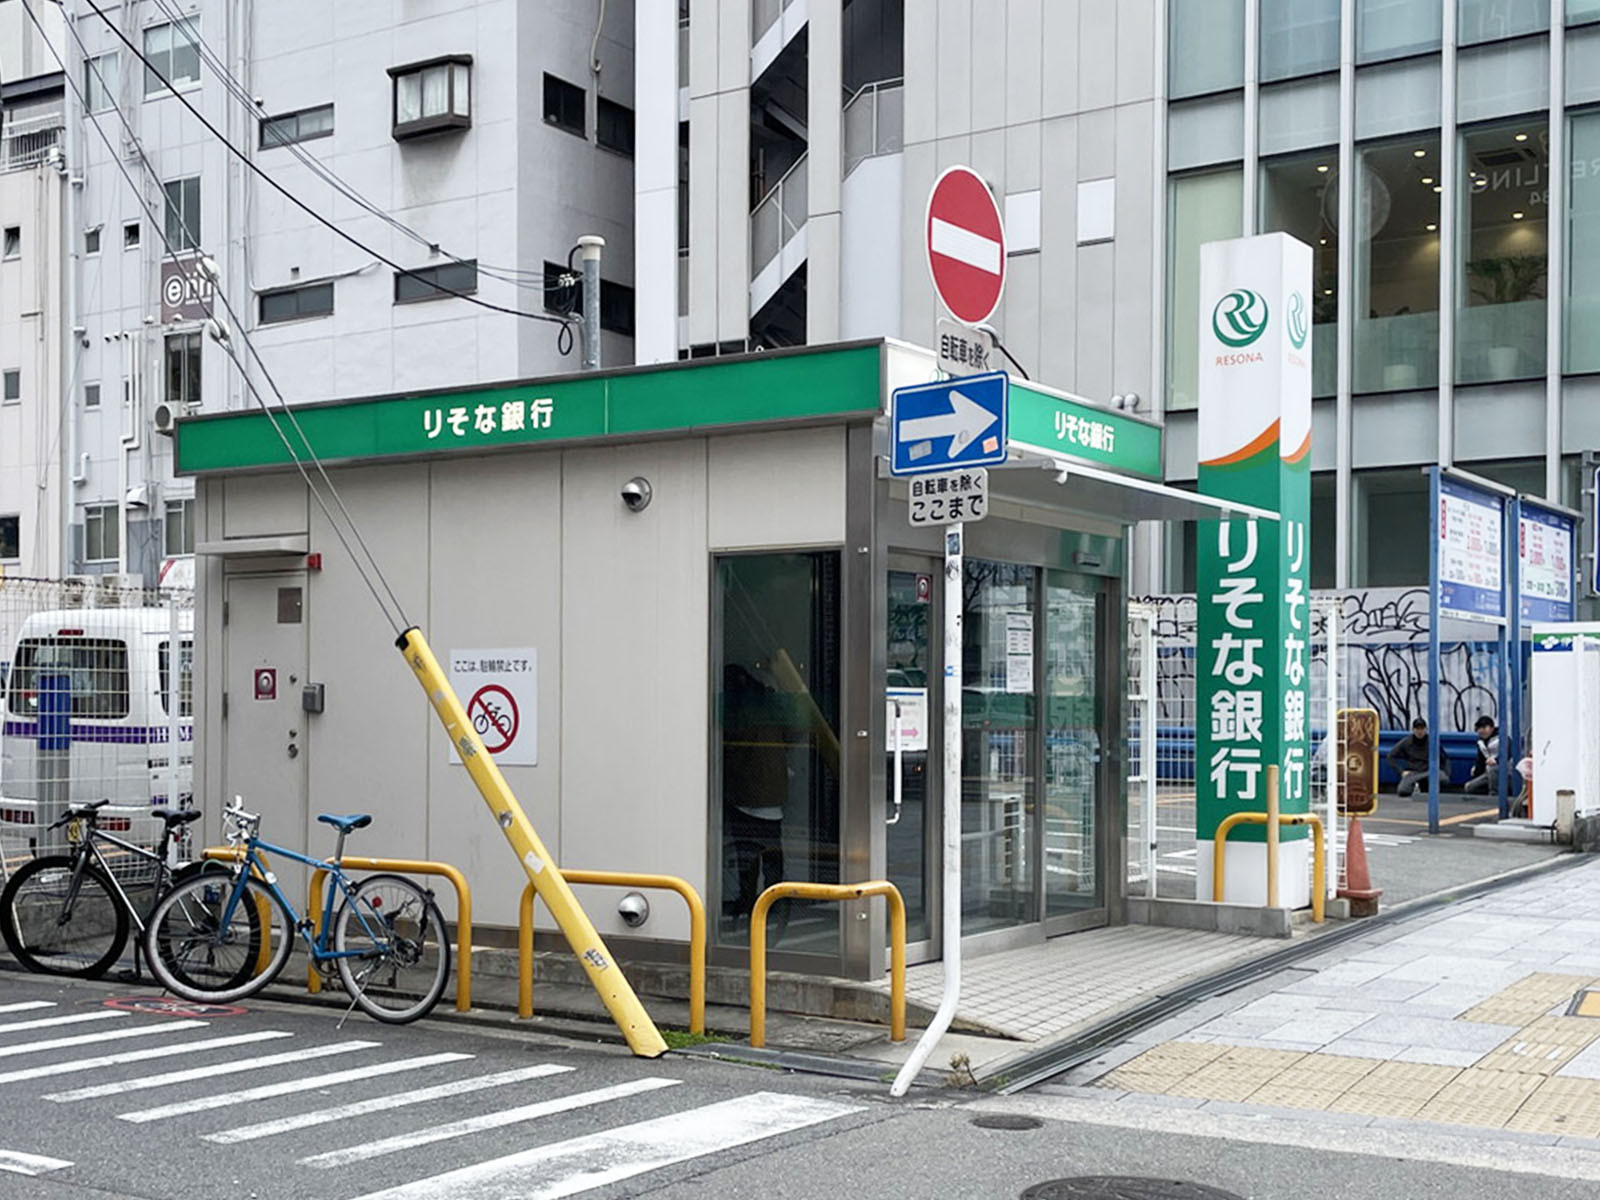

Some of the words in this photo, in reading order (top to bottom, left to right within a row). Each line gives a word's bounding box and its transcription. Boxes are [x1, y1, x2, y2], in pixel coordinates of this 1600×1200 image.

[1216, 352, 1264, 366] RESONA
[424, 398, 554, 438] りそな銀行
[1055, 411, 1115, 453] りそな銀行
[912, 474, 982, 497] 自転車を除く
[912, 495, 983, 522] ここまで
[1210, 519, 1263, 799] りそな銀行
[1284, 520, 1305, 800] りそな銀行
